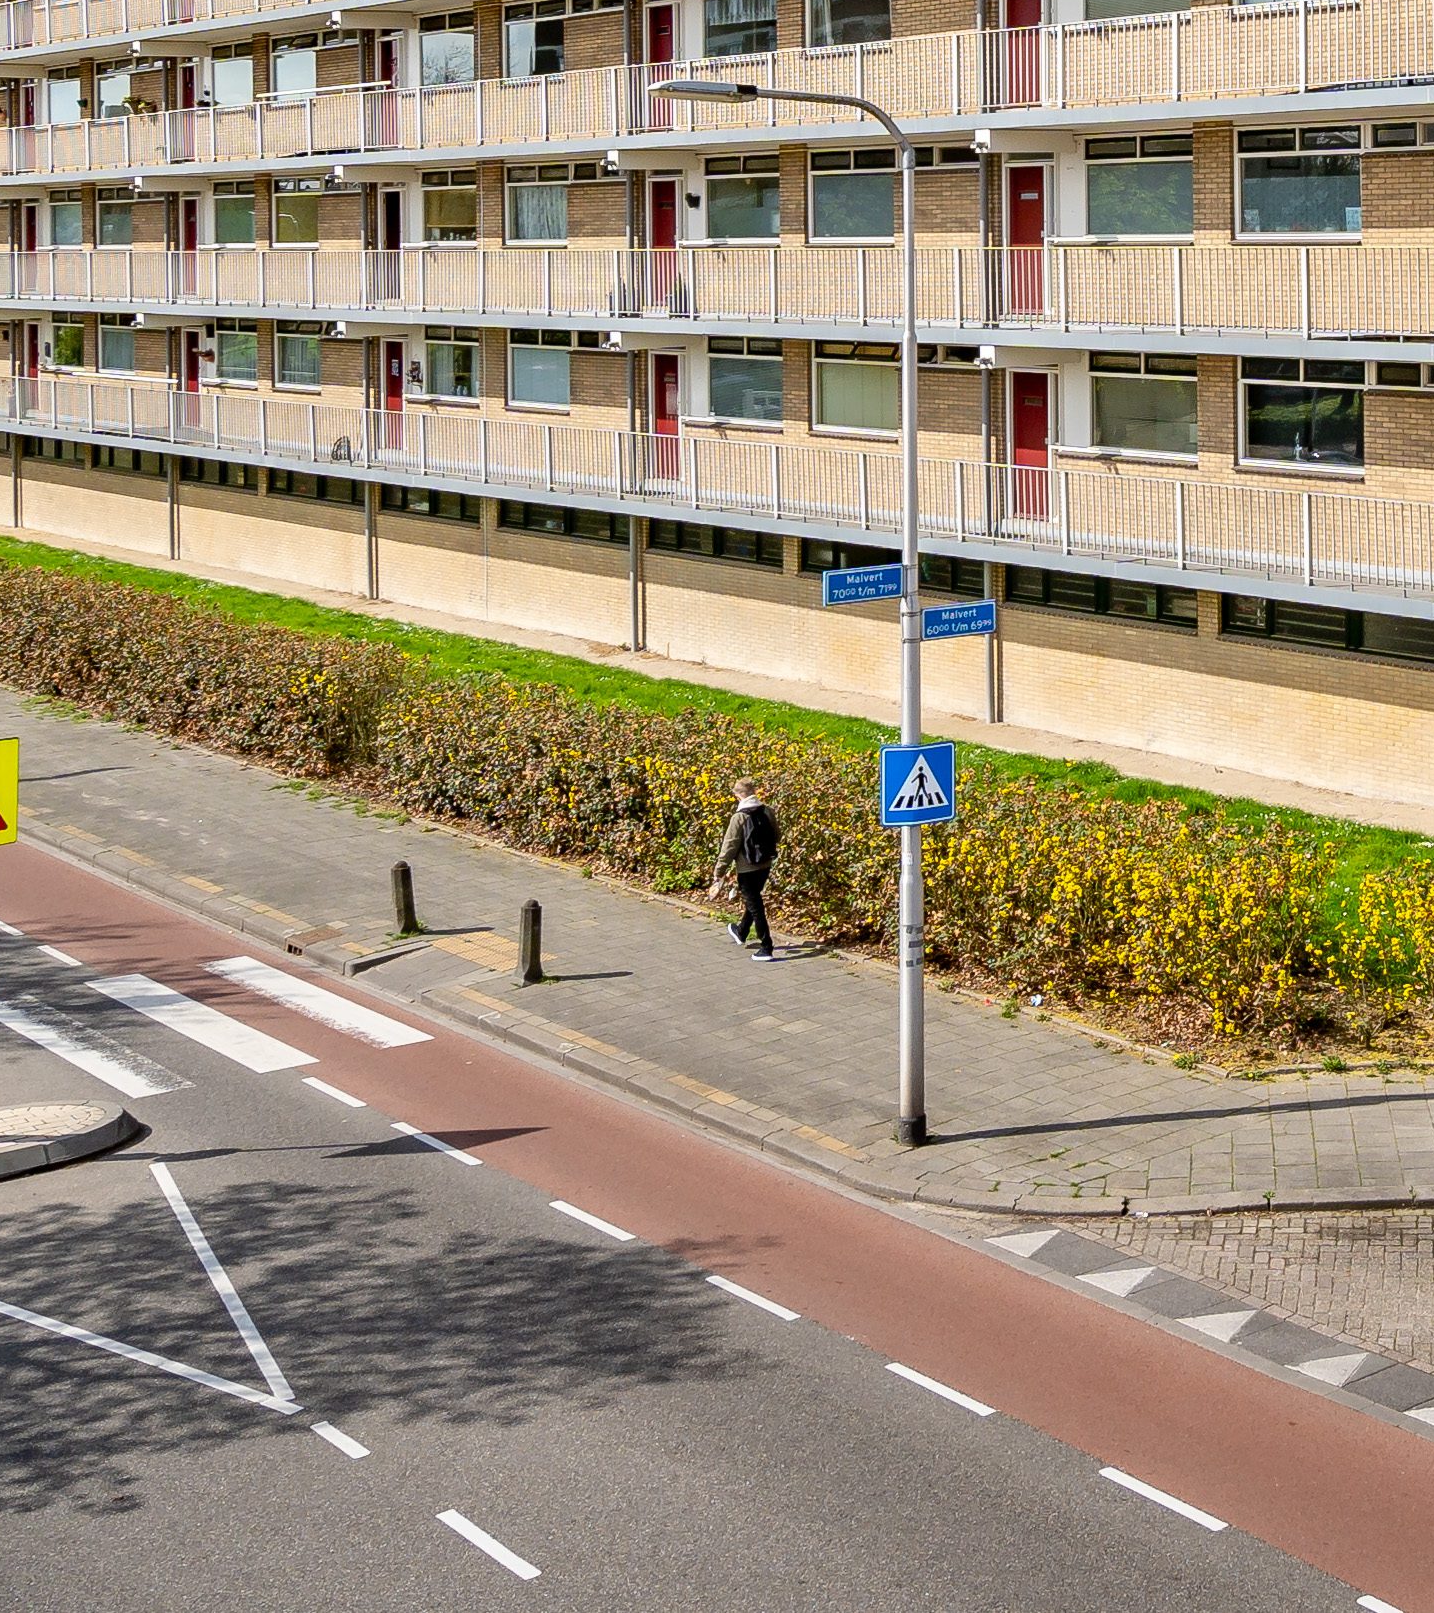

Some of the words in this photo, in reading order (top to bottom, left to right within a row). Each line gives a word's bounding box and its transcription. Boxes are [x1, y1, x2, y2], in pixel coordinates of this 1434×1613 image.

[846, 572, 883, 584] Malvert
[858, 586, 876, 596] t/m
[941, 608, 977, 620] Malvert
[951, 622, 969, 632] t/m
